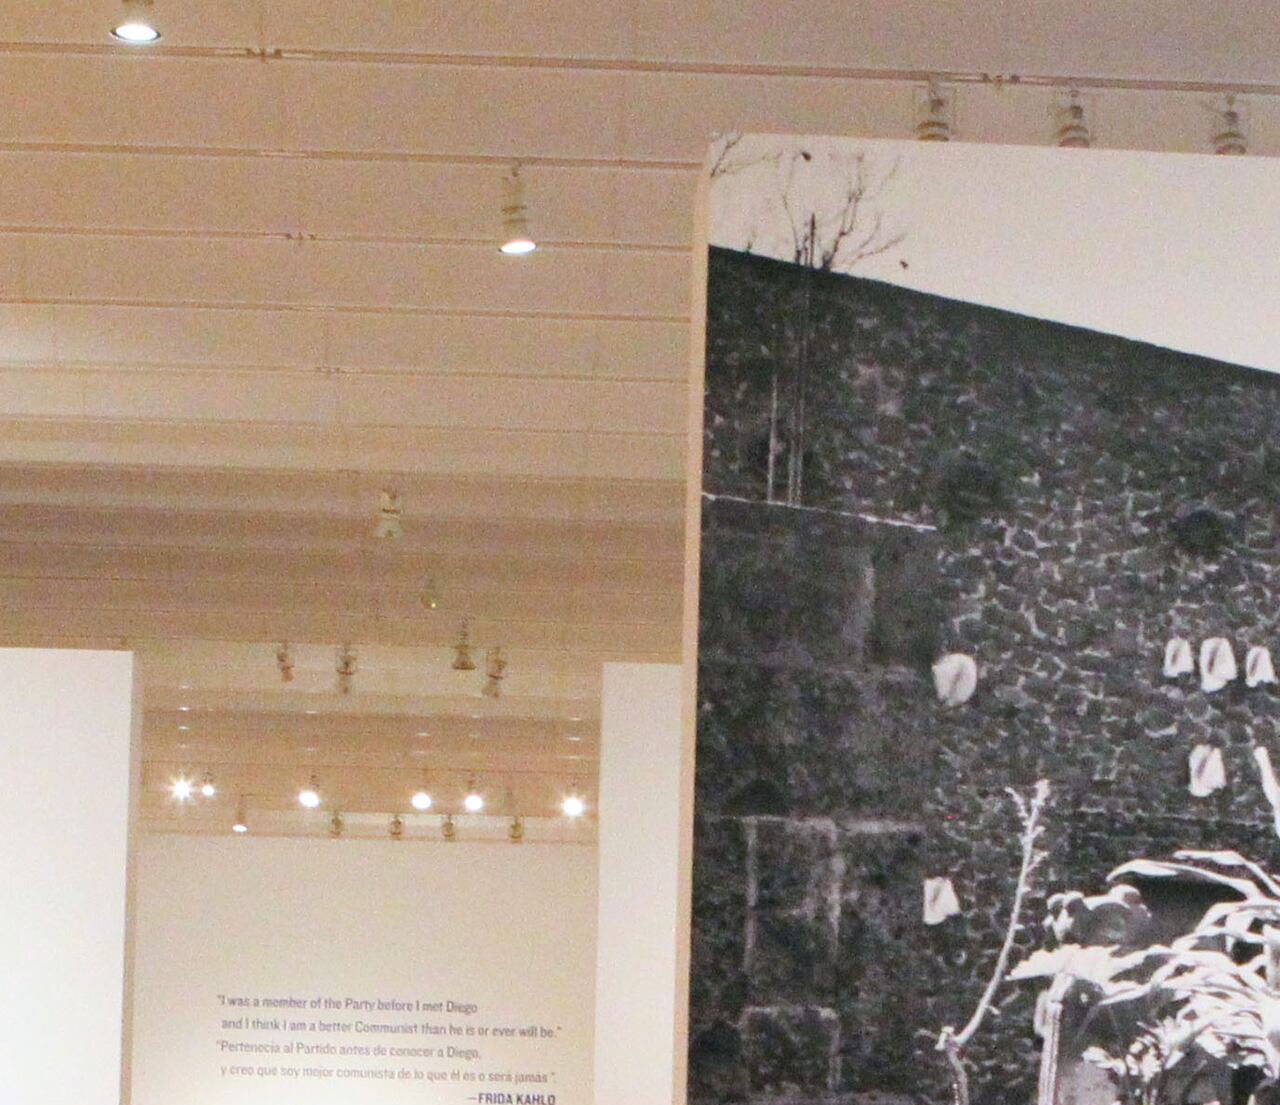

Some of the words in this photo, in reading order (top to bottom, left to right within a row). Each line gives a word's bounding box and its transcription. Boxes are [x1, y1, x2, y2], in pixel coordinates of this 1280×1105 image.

[227, 997, 250, 1009] was
[253, 998, 260, 1008] a
[262, 997, 307, 1010] member
[310, 997, 322, 1010] of
[324, 998, 342, 1011] the
[345, 997, 375, 1013] Party
[377, 998, 412, 1012] before
[422, 1001, 443, 1012] met
[446, 1000, 478, 1016] Diego
[221, 1017, 243, 1030] and
[252, 1018, 281, 1031] think
[290, 1020, 307, 1032] am
[309, 1021, 316, 1032] a
[319, 1020, 352, 1033] better
[354, 1020, 418, 1035] Communist
[421, 1022, 446, 1035] than
[449, 1023, 463, 1036] he
[465, 1024, 476, 1036] is
[478, 1026, 489, 1037] or
[492, 1026, 516, 1038] ever
[518, 1025, 538, 1038] will
[283, 1041, 294, 1054] al
[296, 1042, 337, 1055] Partido
[339, 1044, 371, 1056] antes
[373, 1044, 387, 1056] de
[389, 1046, 435, 1058] conocer
[437, 1048, 444, 1058] a
[221, 1066, 228, 1077] y
[230, 1066, 255, 1077] creo
[257, 1066, 278, 1079] que
[280, 1067, 300, 1079] soy
[302, 1066, 334, 1079] mejor
[336, 1067, 396, 1080] comunista
[398, 1068, 411, 1080] de
[414, 1069, 424, 1080] lo
[426, 1070, 448, 1083] que
[463, 1072, 476, 1082] es
[478, 1072, 485, 1081] o
